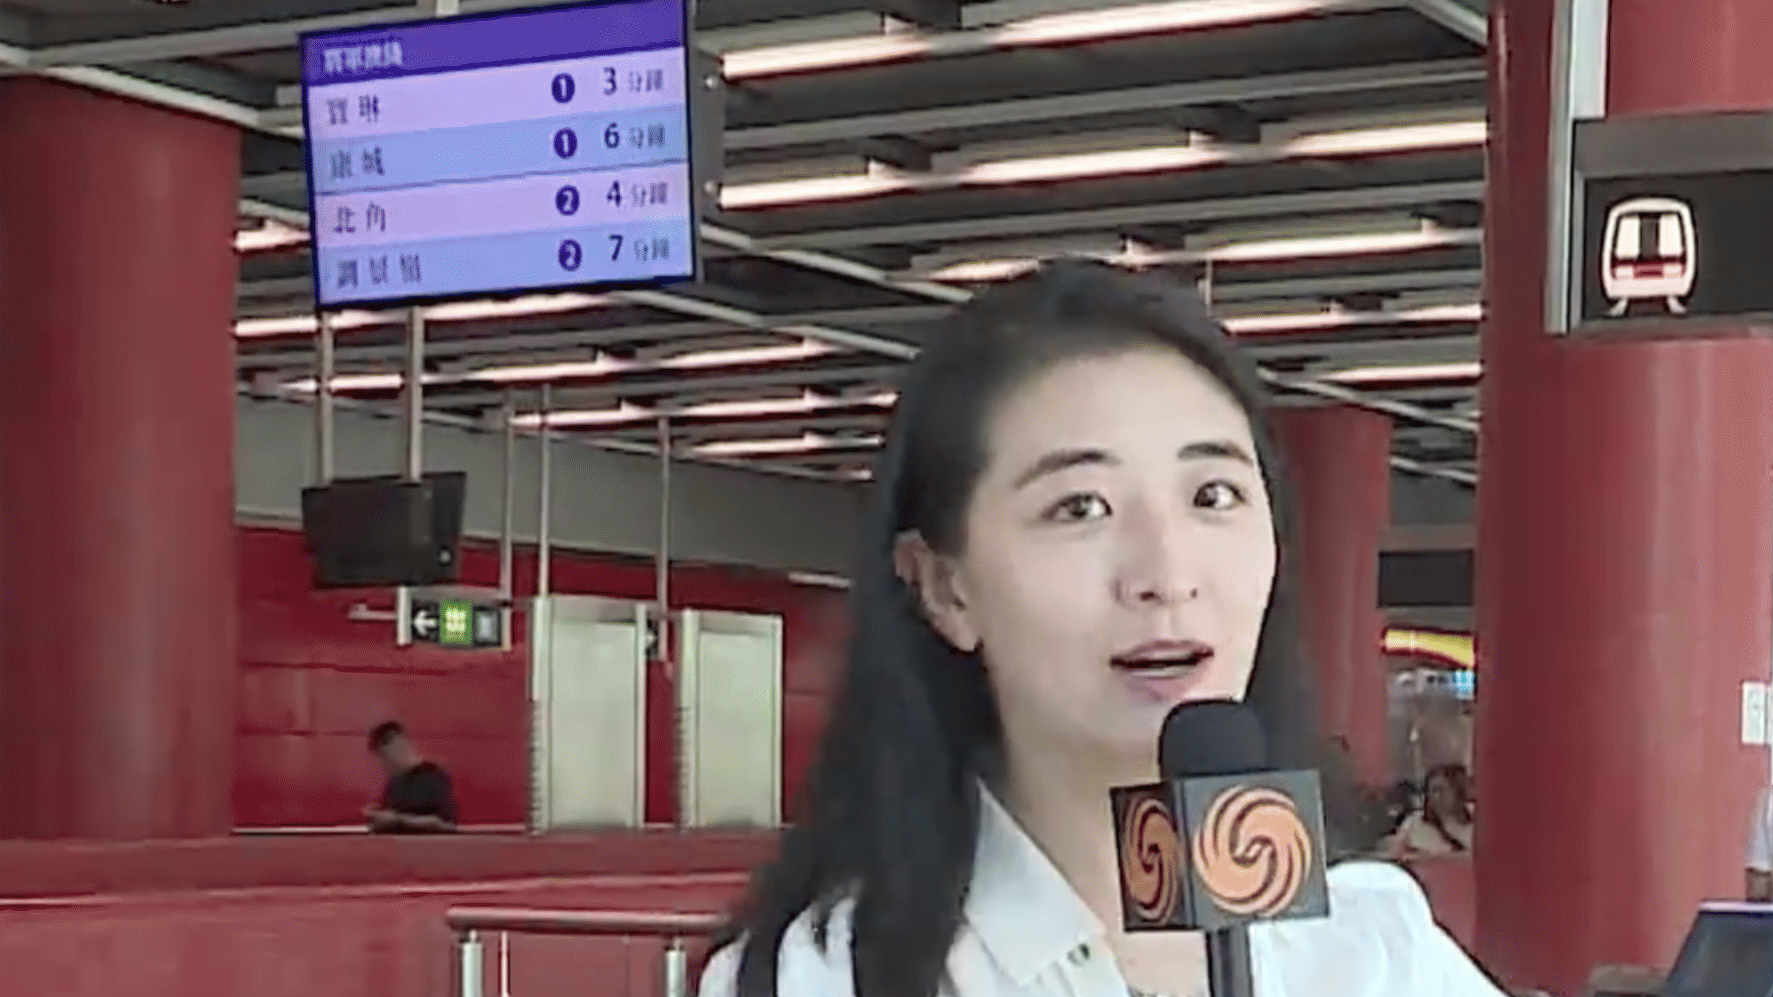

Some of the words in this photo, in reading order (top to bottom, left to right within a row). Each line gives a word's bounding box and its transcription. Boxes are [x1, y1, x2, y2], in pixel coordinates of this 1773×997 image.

[603, 67, 618, 95] 3
[329, 146, 385, 180] 康城
[604, 122, 621, 149] 6
[333, 201, 387, 234] 北角
[606, 180, 622, 208] 4
[609, 234, 624, 262] 7
